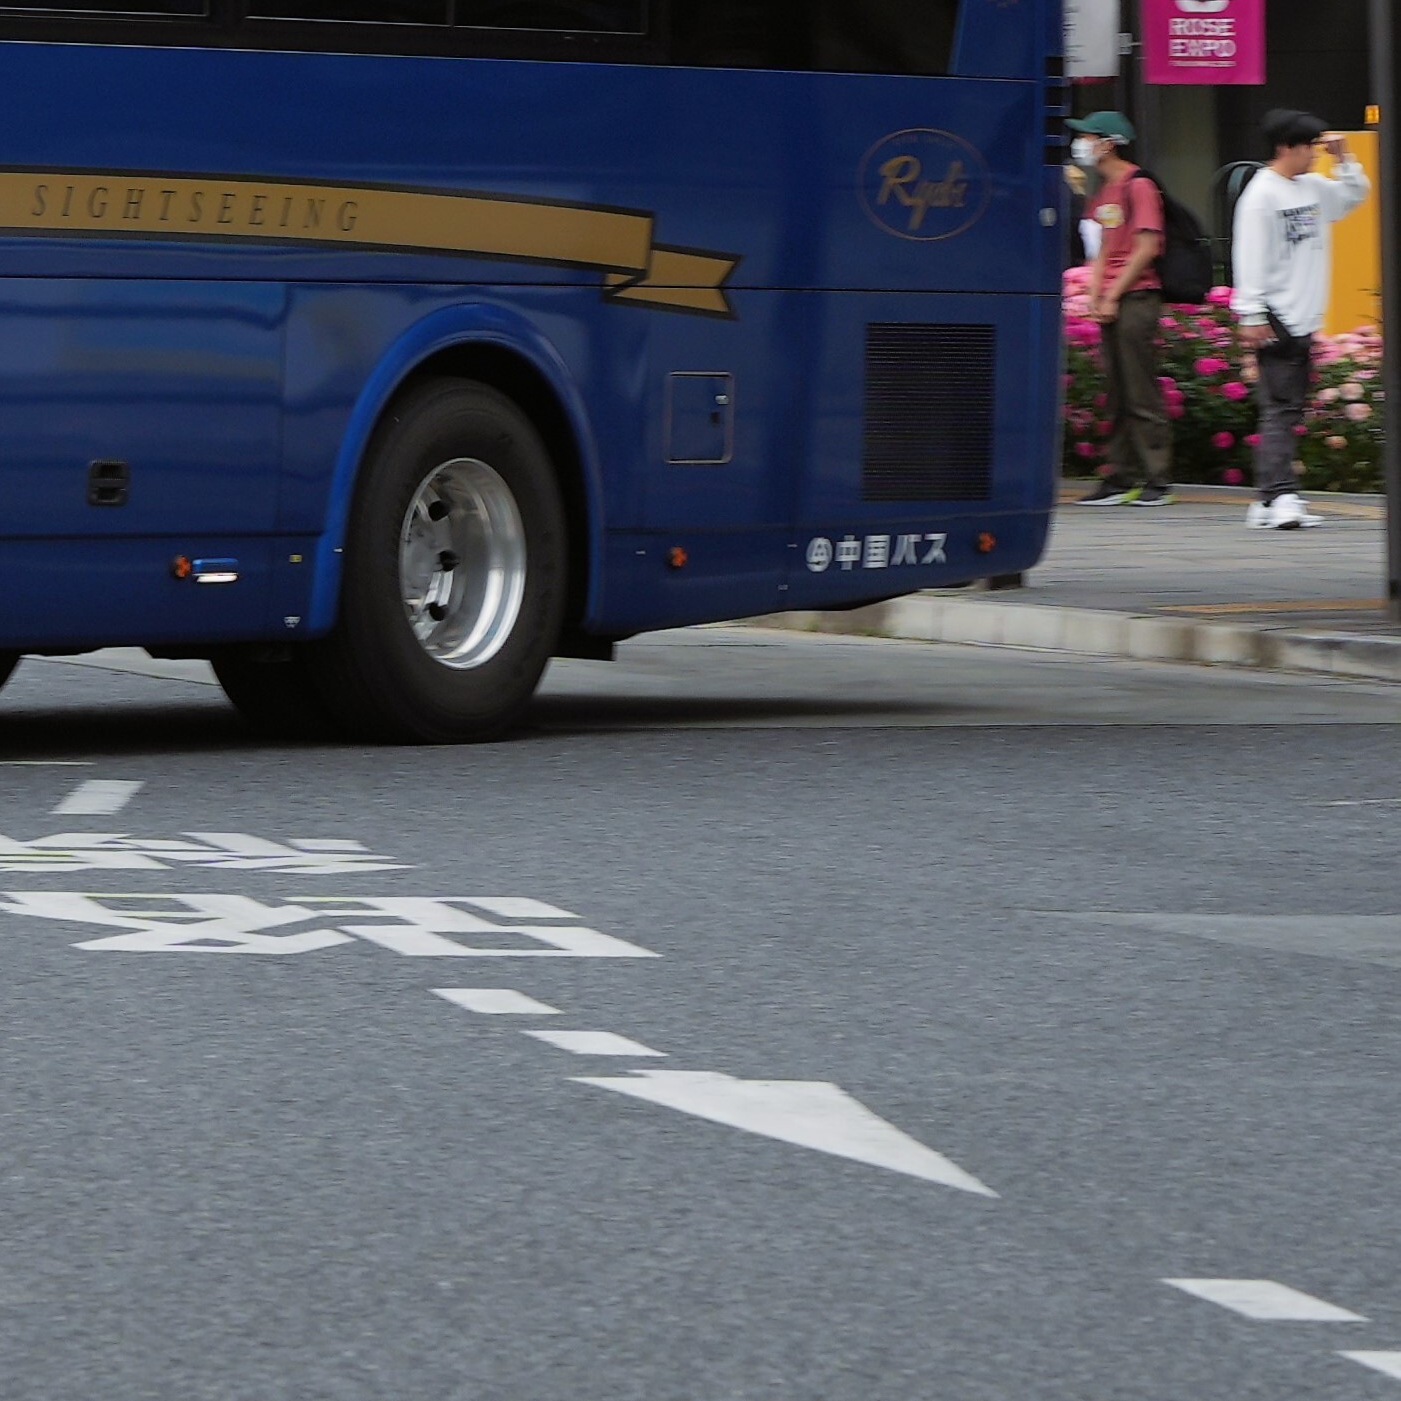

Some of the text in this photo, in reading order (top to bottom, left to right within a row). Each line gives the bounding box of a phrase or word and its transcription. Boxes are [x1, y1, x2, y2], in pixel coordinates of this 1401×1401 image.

[1168, 18, 1237, 36] ROSE
[1168, 38, 1237, 58] EXPO
[31, 182, 359, 233] SIGHTSEEING
[834, 532, 948, 571] 中国バス
